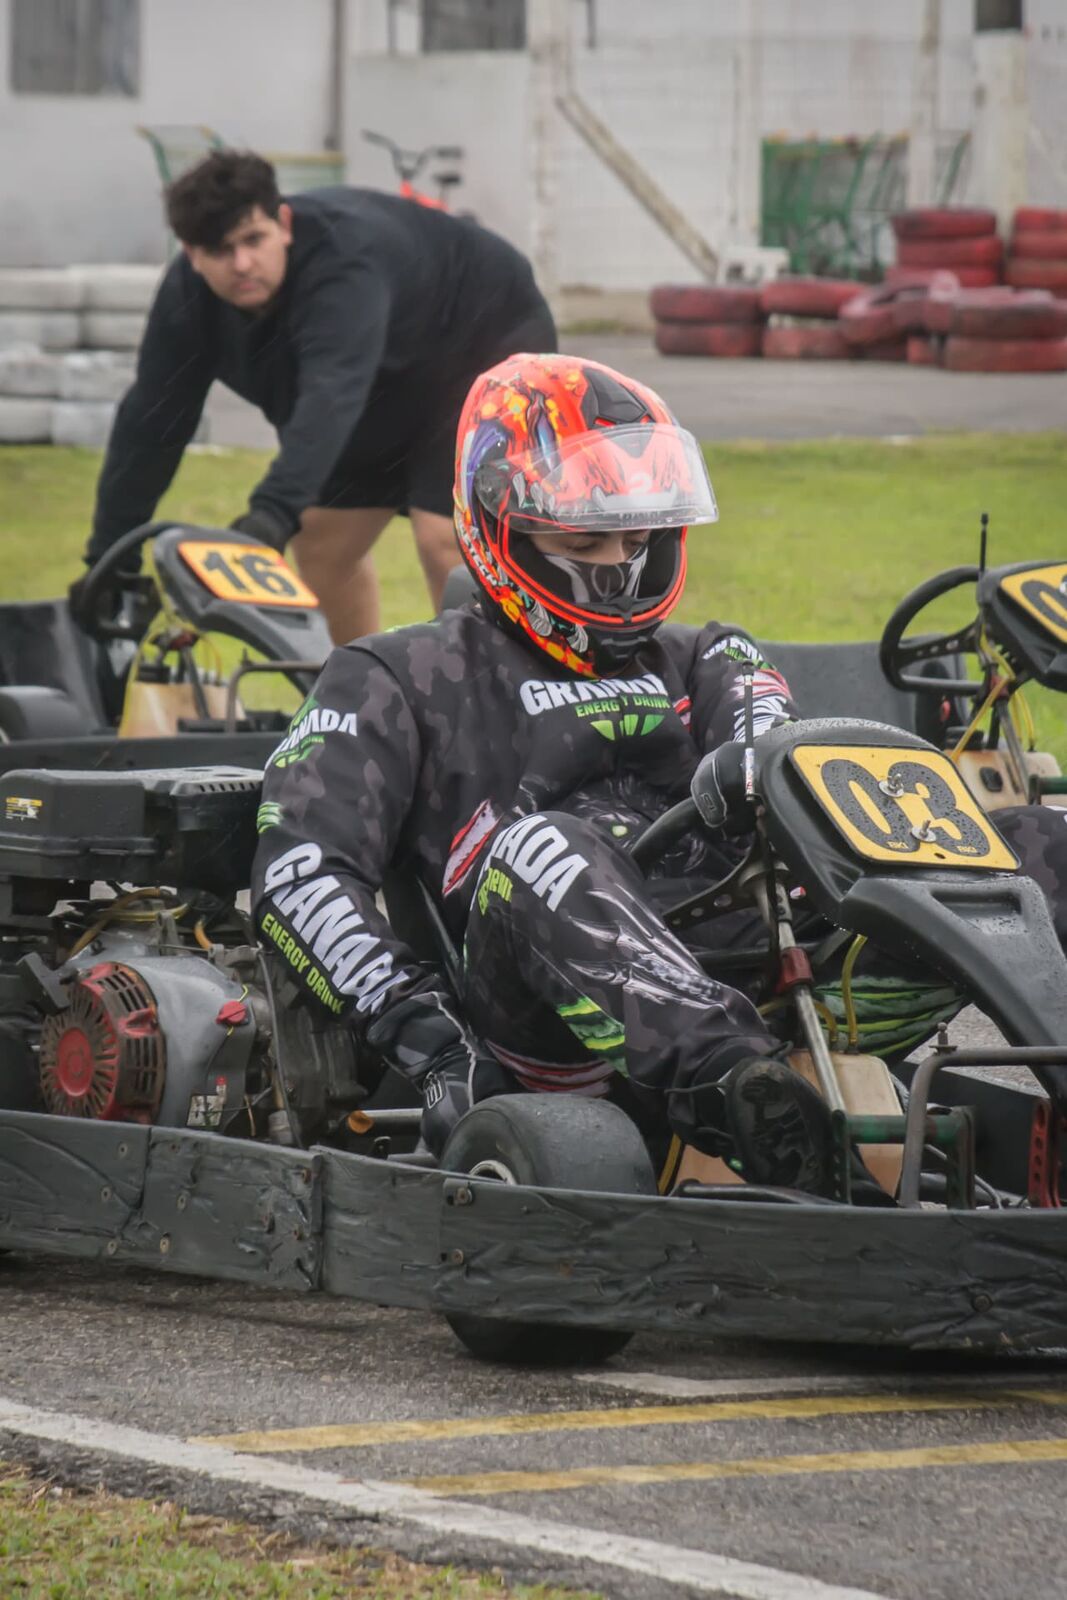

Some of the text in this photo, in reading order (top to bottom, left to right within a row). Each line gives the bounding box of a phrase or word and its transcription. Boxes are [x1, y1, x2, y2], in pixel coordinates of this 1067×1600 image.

[202, 550, 297, 598] 16
[575, 694, 671, 718] ENERGY DRINK
[820, 758, 991, 858] 03
[261, 912, 345, 1015] ENERGY DRINK
